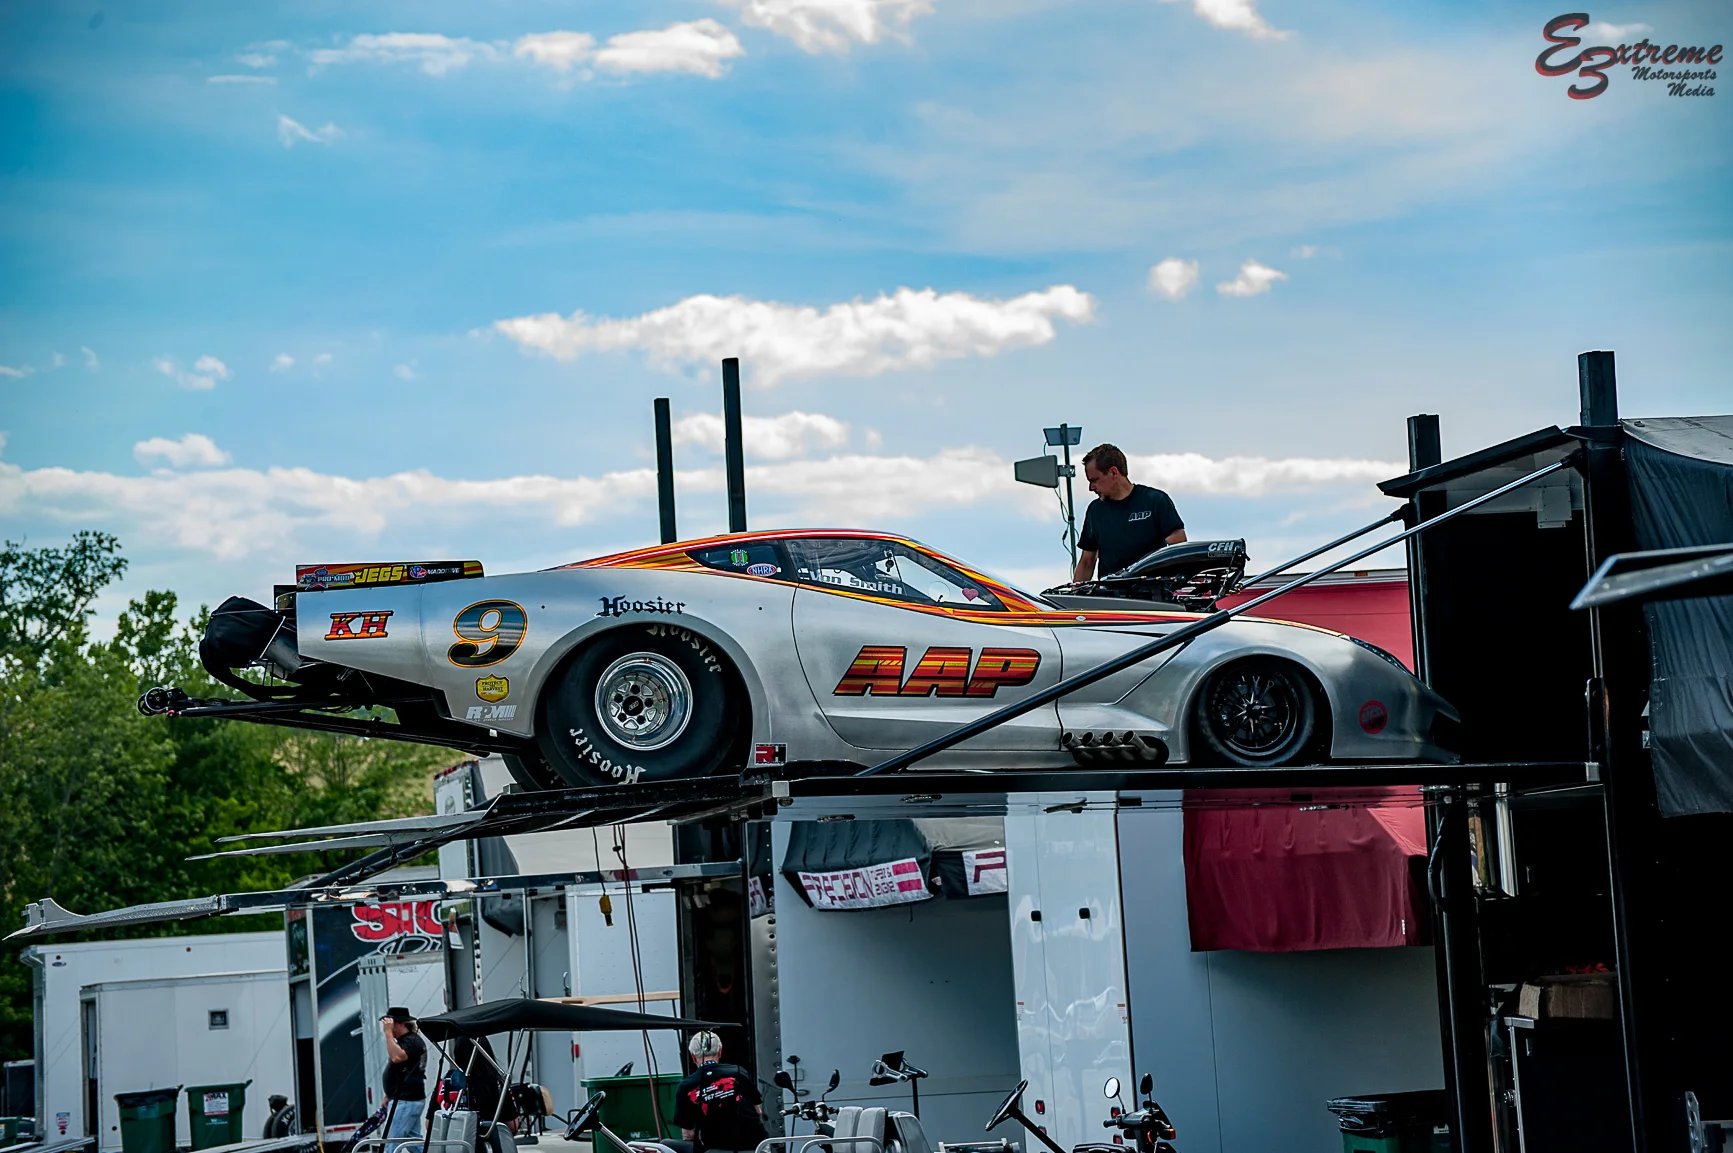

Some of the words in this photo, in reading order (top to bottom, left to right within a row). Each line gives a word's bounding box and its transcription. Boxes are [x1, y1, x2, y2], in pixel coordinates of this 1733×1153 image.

[1129, 510, 1152, 522] AAP
[355, 565, 403, 583] JEGS
[752, 565, 773, 575] NHRA
[849, 576, 904, 595] Smith
[594, 595, 686, 617] Hoosier
[324, 610, 394, 641] KH
[448, 599, 528, 668] 9
[832, 645, 1042, 699] AAP
[569, 727, 647, 785] Hoosier
